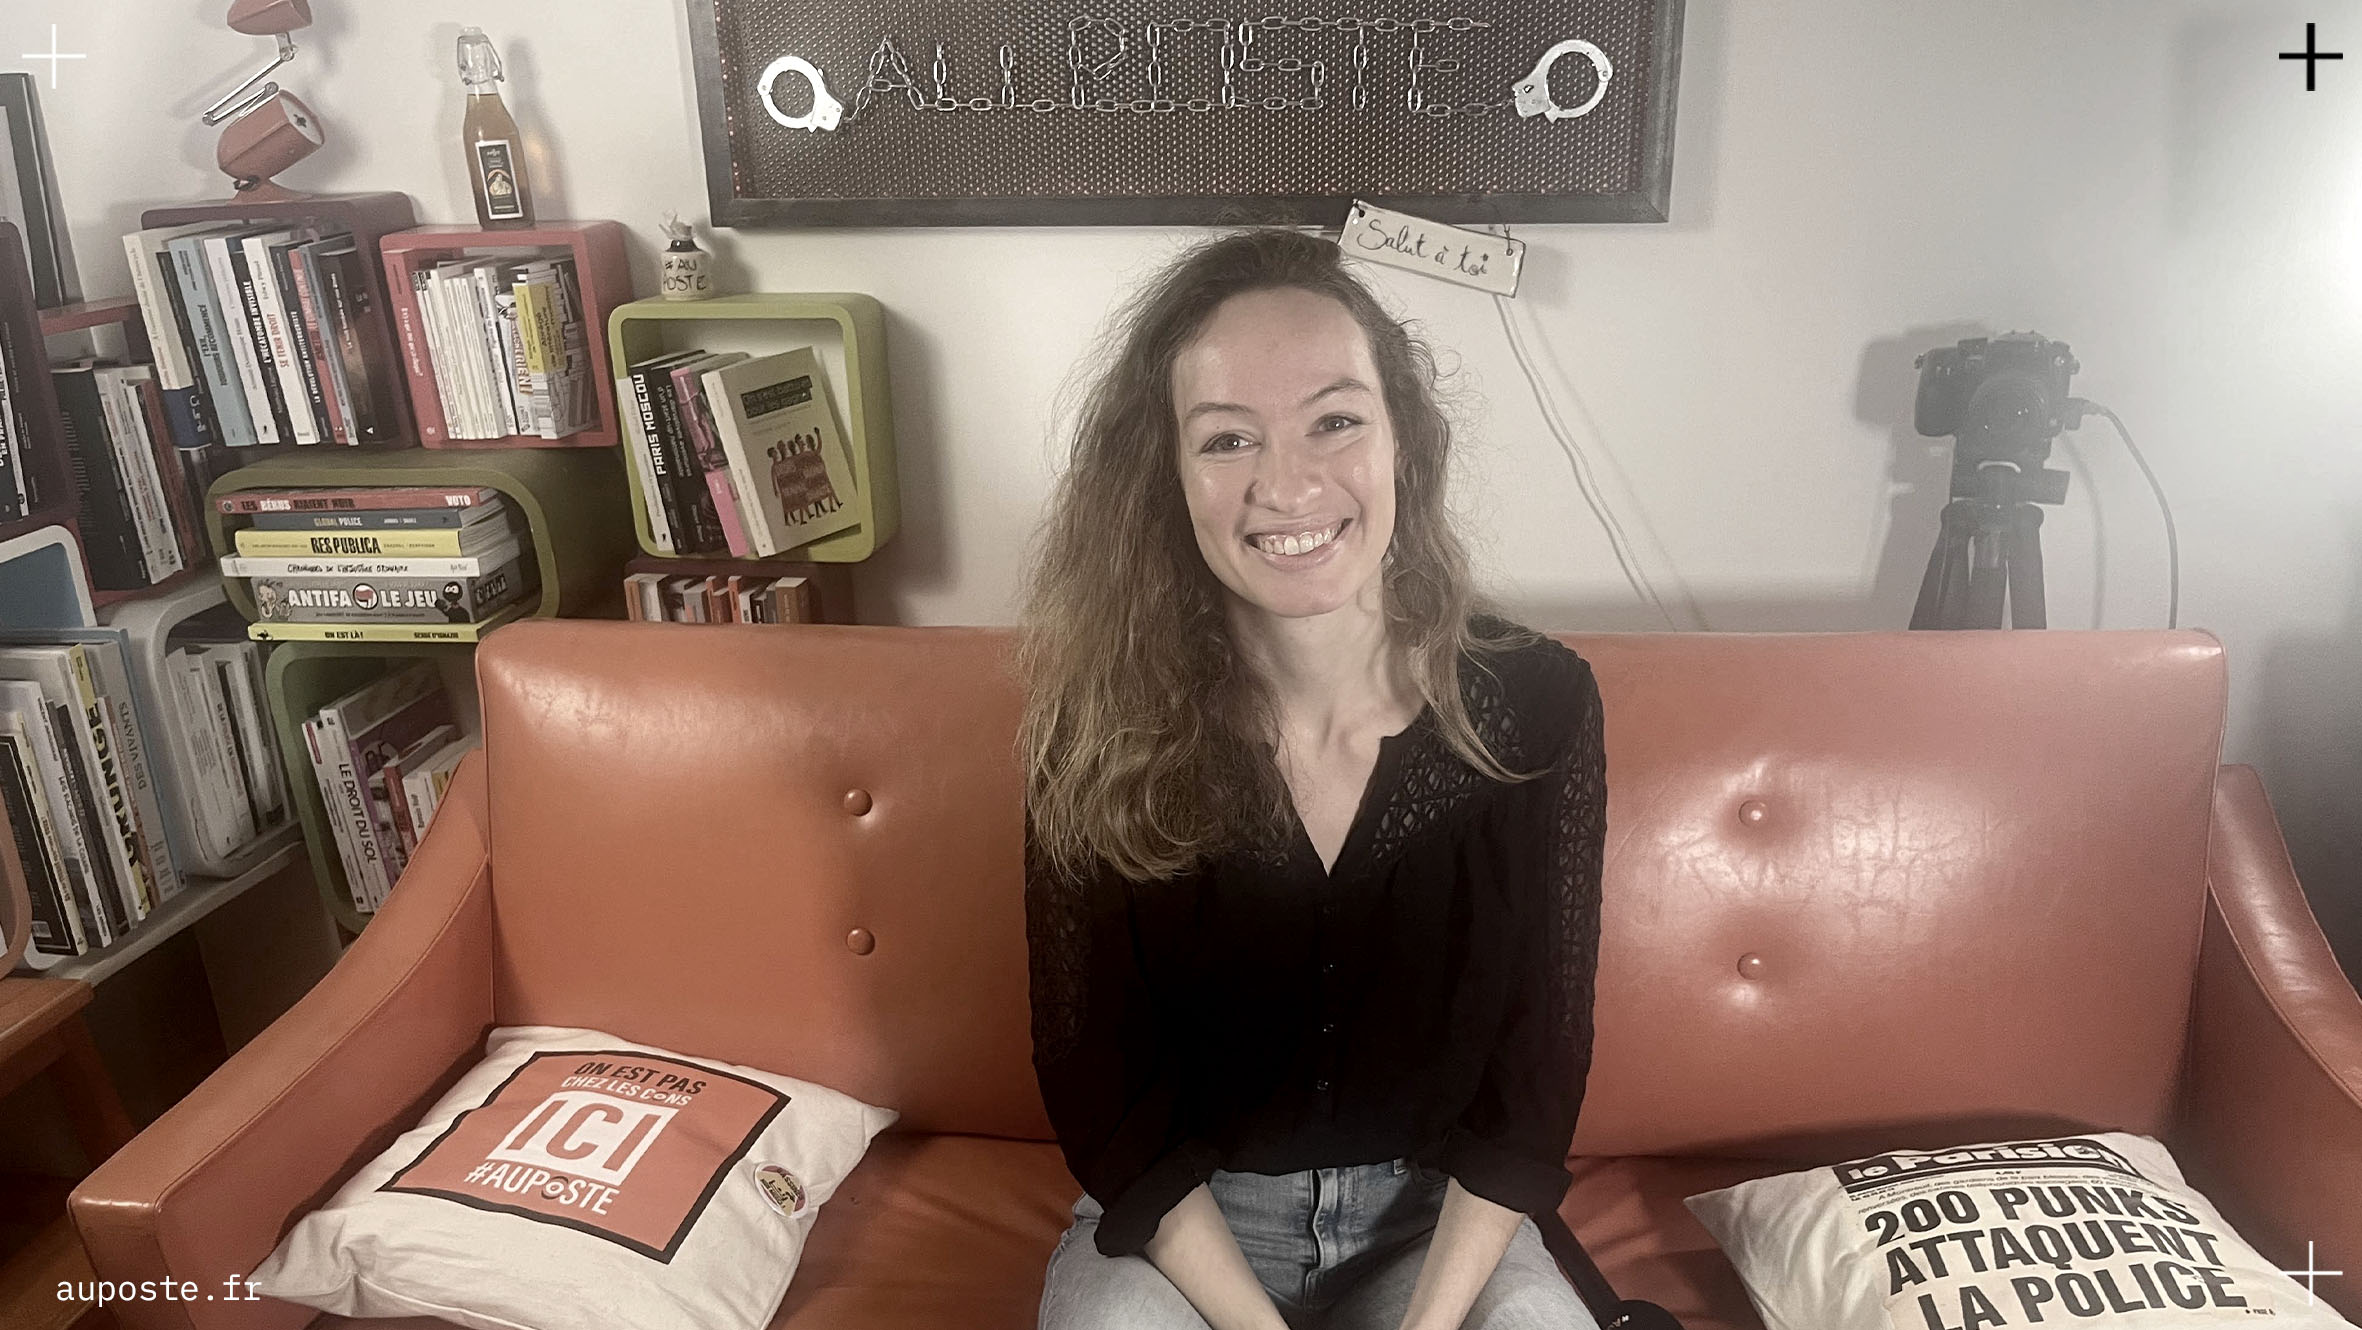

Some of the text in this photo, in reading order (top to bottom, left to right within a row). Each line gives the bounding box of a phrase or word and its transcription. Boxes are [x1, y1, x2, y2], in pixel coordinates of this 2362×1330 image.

[1357, 219, 1489, 275] Salut à toi
[243, 281, 258, 315] INVISIBLE
[267, 314, 280, 335] DROIT
[274, 338, 286, 357] TENIR
[633, 374, 656, 430] MOSCOU
[648, 434, 666, 474] PARIS
[445, 495, 471, 507] VOTO
[338, 517, 363, 527] POLICE
[311, 537, 333, 554] RES
[332, 537, 381, 554] PUBLICA
[288, 589, 438, 607] ANTIFA LE JEU
[119, 702, 147, 790] DES VIVANTS
[339, 764, 376, 864] LE DROIT DU SOL
[561, 1076, 606, 1090] CHEZ
[609, 1080, 641, 1097] LES
[574, 1062, 707, 1095] ON EST PAS
[507, 1099, 662, 1173] ICI
[1848, 1142, 2138, 1180] le Parisien
[464, 1162, 620, 1216] #AUPOSTE
[1865, 1189, 1980, 1247] 200
[1990, 1184, 2201, 1226] PUNKS
[1886, 1218, 2226, 1296] ATTAQUENT
[1917, 1260, 2248, 1330] LA POLICE
